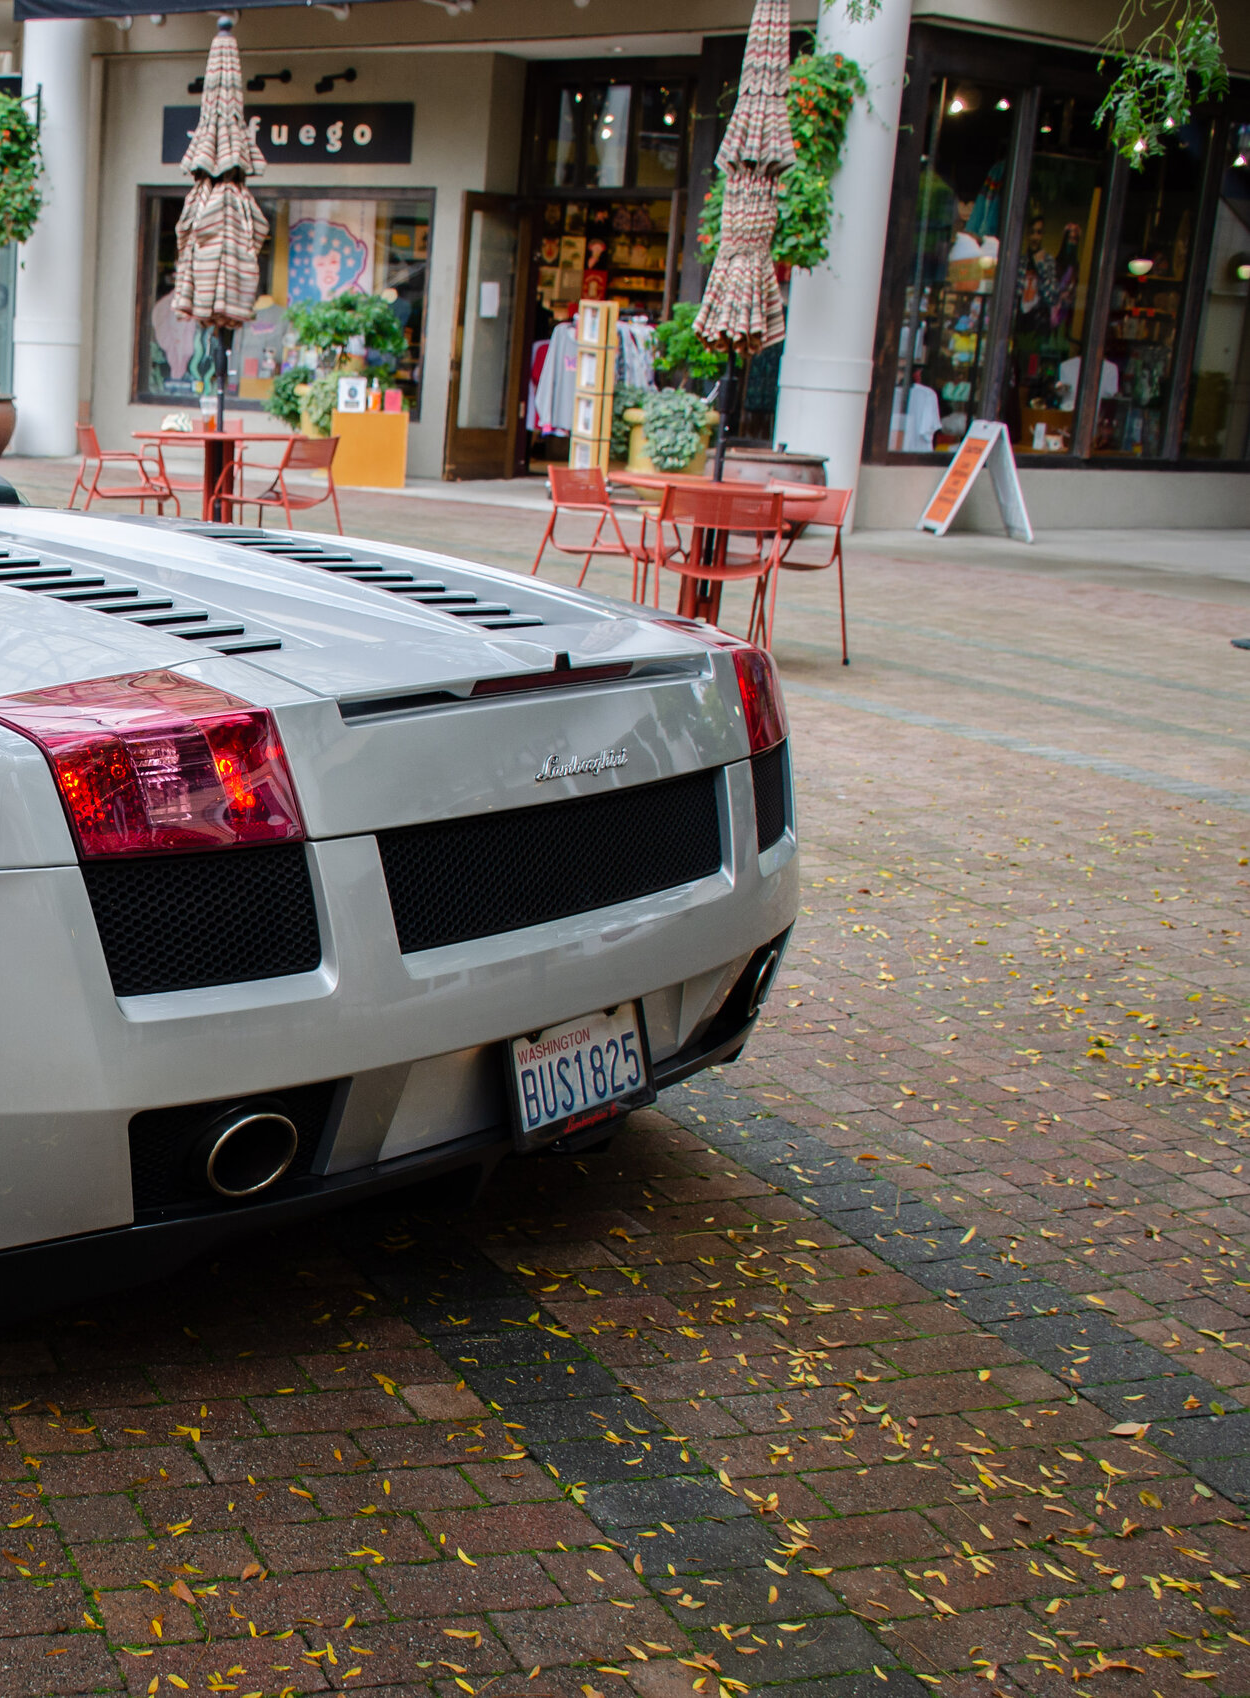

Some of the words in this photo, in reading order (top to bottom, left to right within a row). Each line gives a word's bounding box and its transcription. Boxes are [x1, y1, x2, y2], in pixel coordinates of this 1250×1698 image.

[535, 747, 628, 781] Lamborghini
[517, 1028, 590, 1065] WASHINGTON
[520, 1030, 641, 1127] BUS1825
